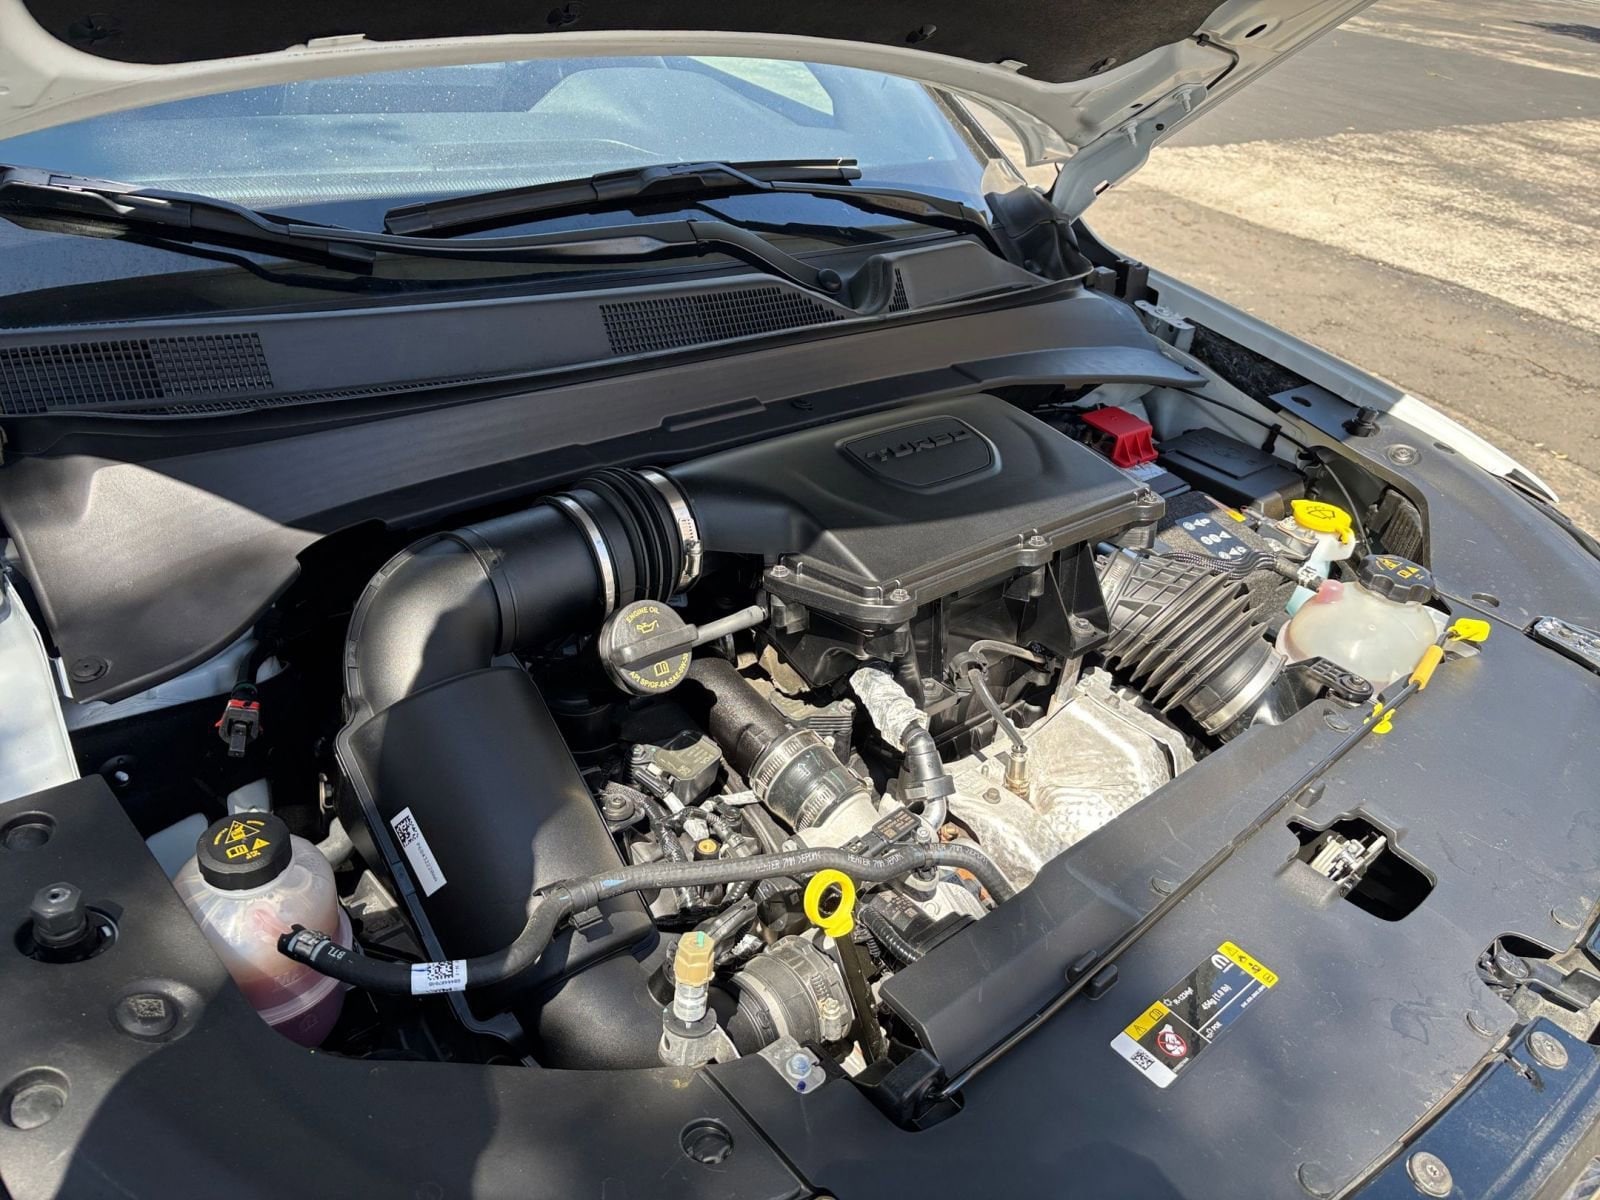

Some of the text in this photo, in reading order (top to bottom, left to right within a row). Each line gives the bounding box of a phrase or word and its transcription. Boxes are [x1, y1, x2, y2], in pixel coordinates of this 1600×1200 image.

[626, 606, 660, 623] ENGINE OIL
[629, 671, 641, 682] API
[847, 854, 871, 867] HEATER
[327, 945, 346, 960] BTL
